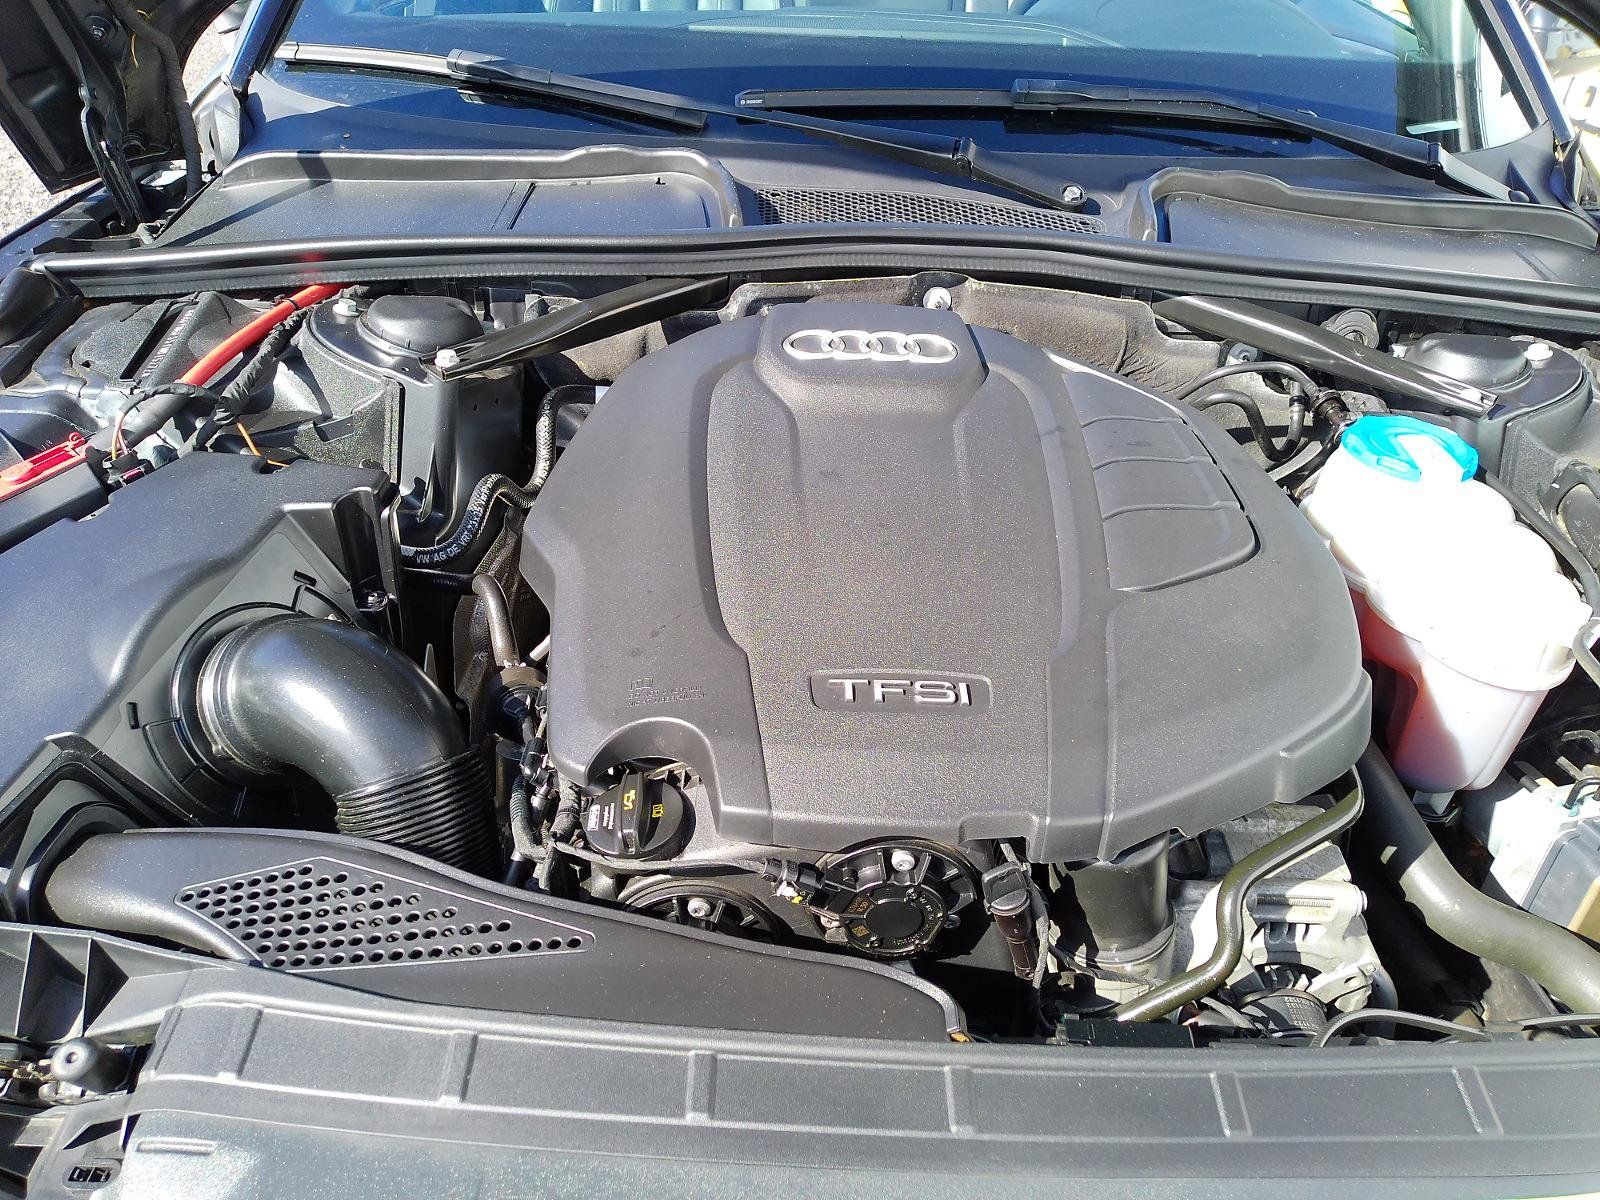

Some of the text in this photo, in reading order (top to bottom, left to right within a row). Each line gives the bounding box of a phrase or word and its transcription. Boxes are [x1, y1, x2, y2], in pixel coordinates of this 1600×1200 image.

[433, 553, 447, 562] AG
[447, 544, 461, 557] DE
[828, 678, 971, 707] TFSI
